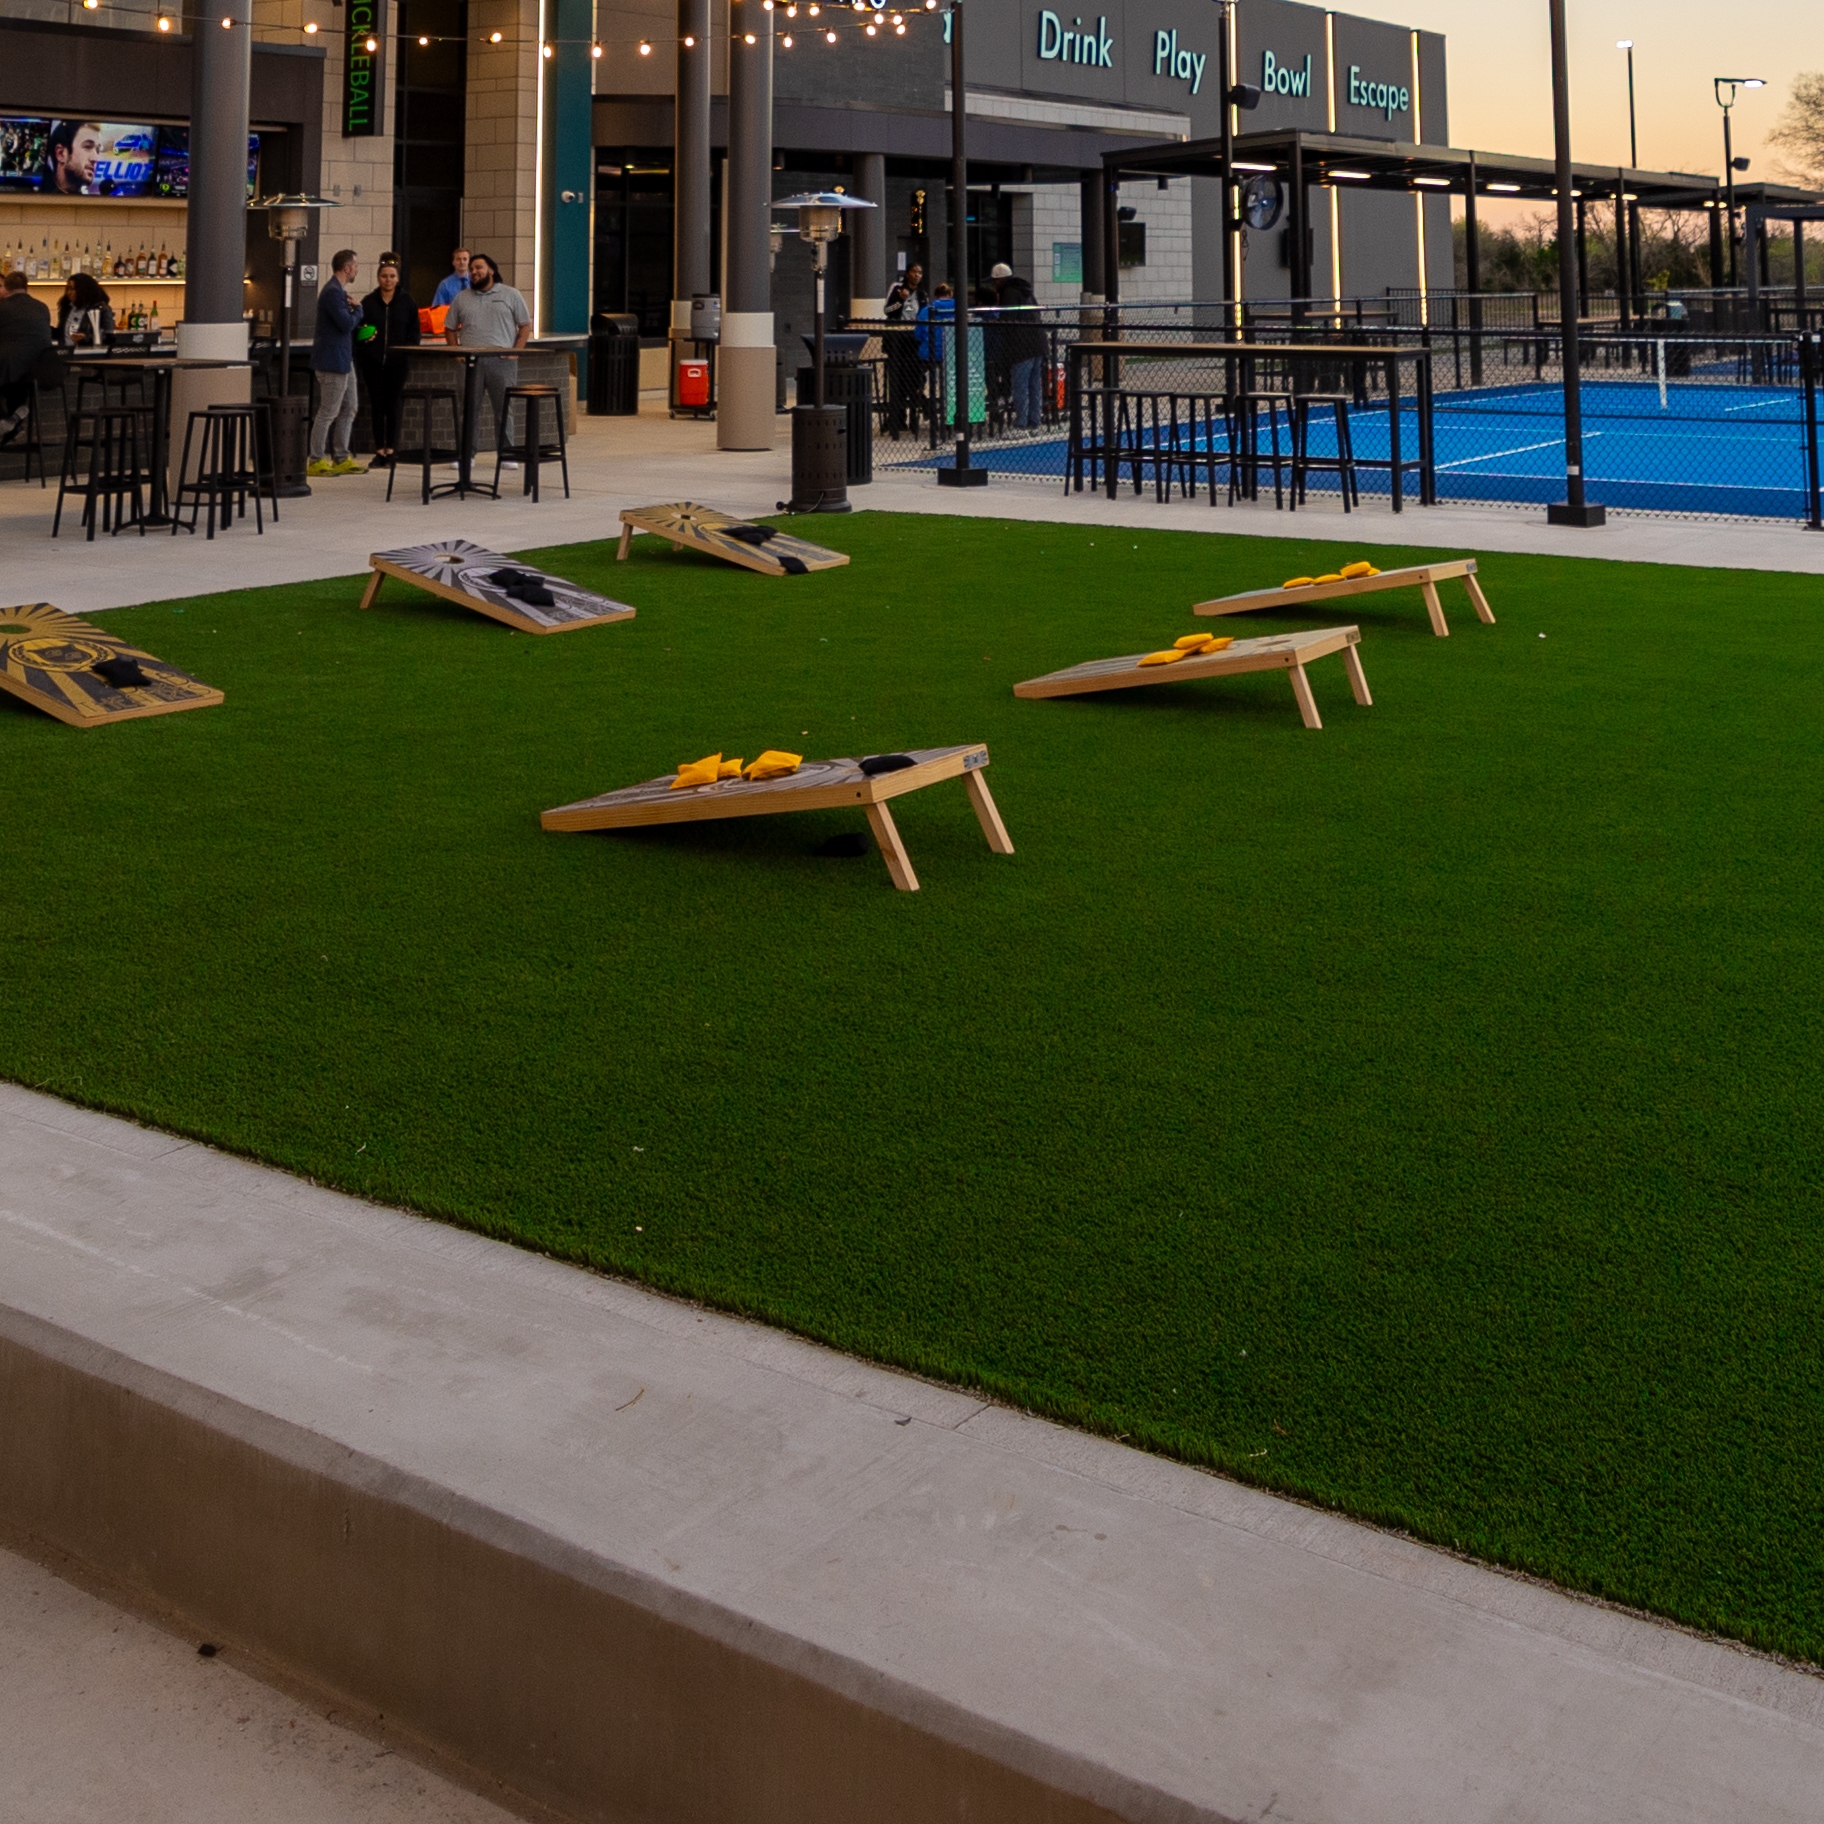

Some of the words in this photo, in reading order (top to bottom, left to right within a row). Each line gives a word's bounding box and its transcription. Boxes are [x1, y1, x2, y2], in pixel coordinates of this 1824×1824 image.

[1039, 10, 1113, 67] Drink
[1154, 29, 1206, 94] Play
[1263, 50, 1311, 97] Bowl
[1349, 65, 1409, 121] Escape
